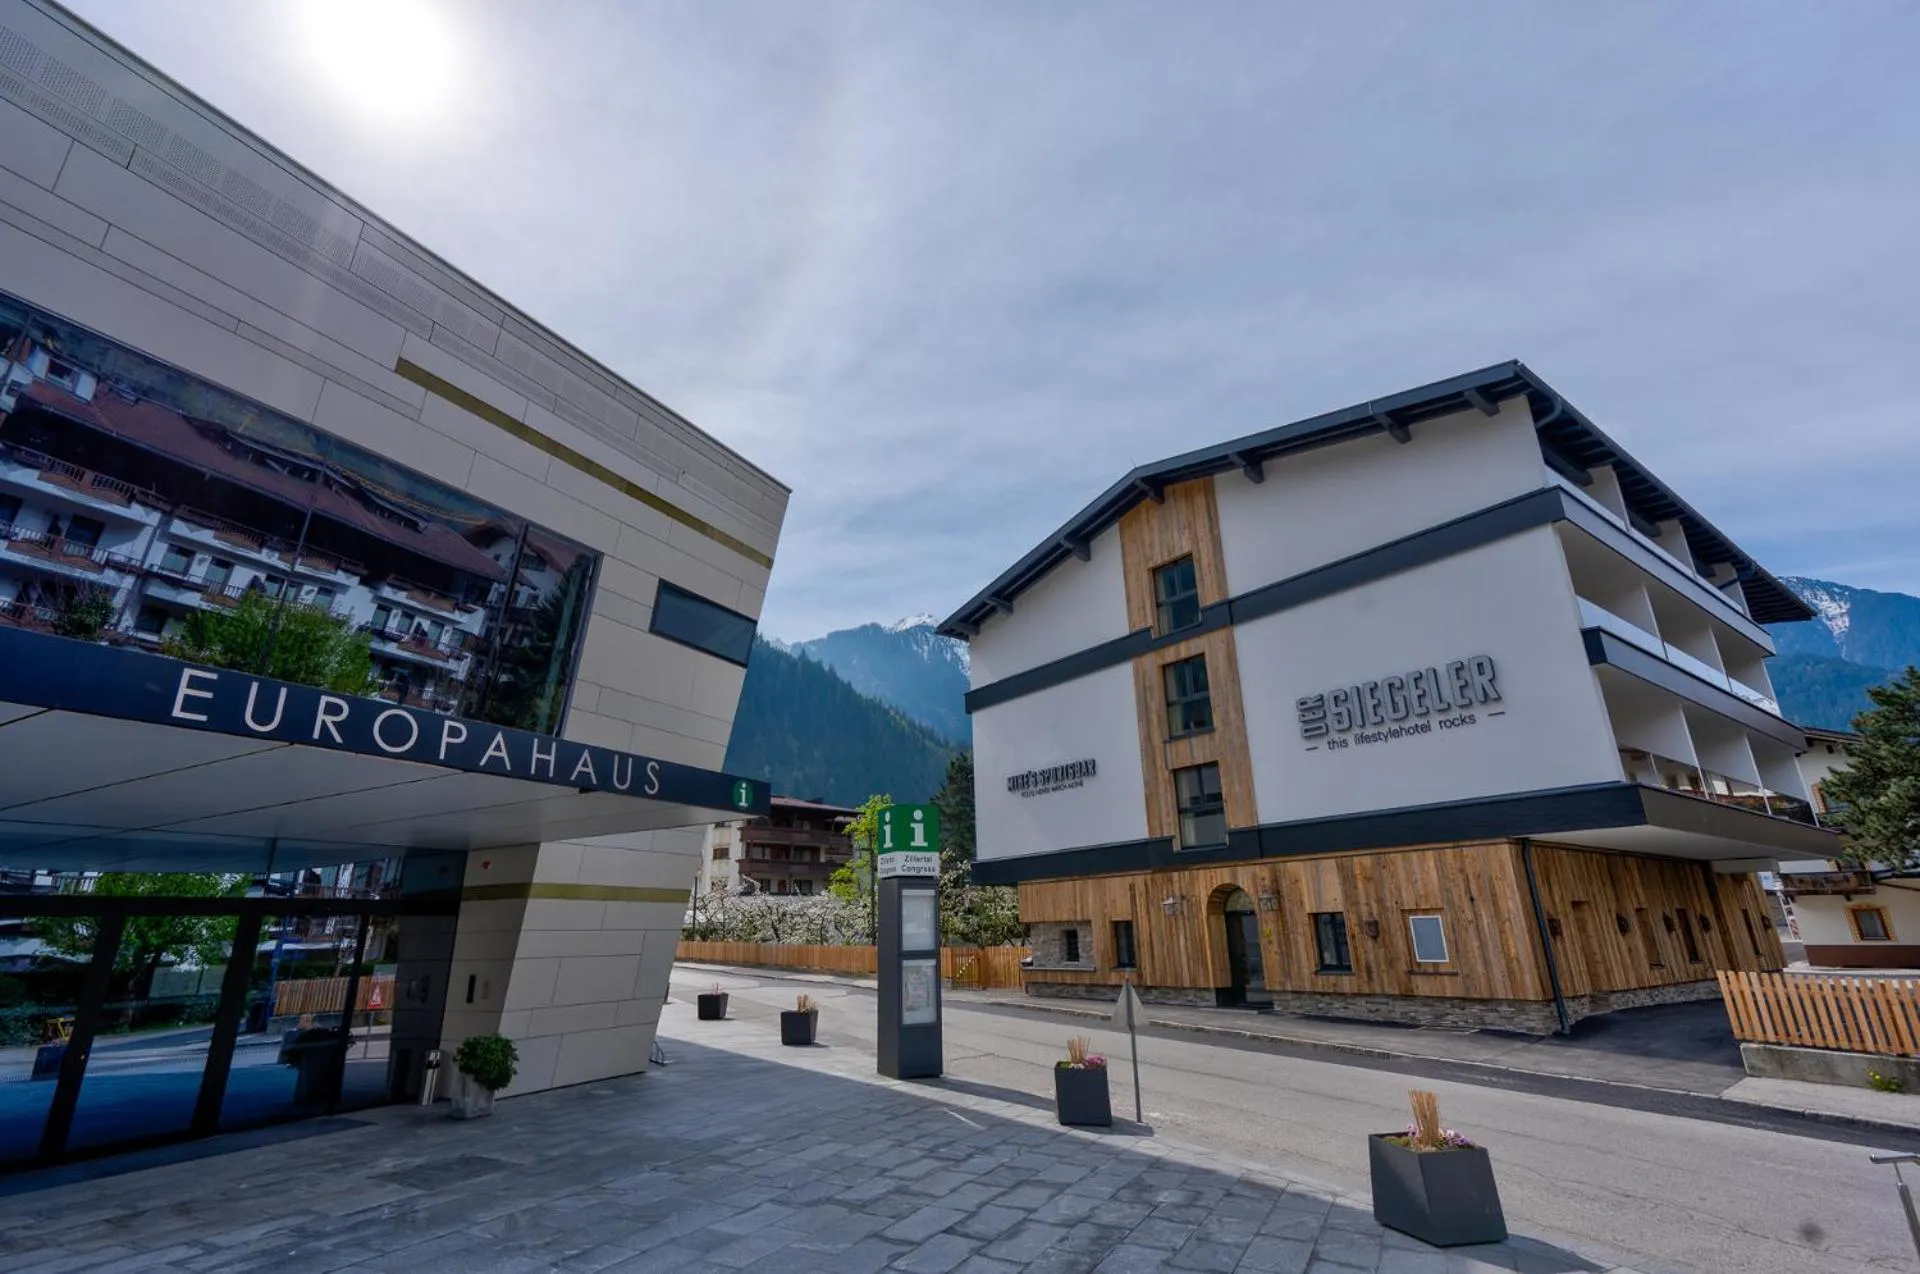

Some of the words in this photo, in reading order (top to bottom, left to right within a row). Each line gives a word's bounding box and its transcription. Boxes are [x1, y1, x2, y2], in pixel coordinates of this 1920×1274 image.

[1326, 654, 1503, 732] SIEGELER
[171, 667, 660, 795] EUROPAHAUS
[1296, 694, 1329, 740] DER
[1327, 737, 1349, 750] this
[1354, 720, 1432, 746] lifestylehotel
[1439, 713, 1477, 730] rocks
[901, 864, 936, 874] Congress
